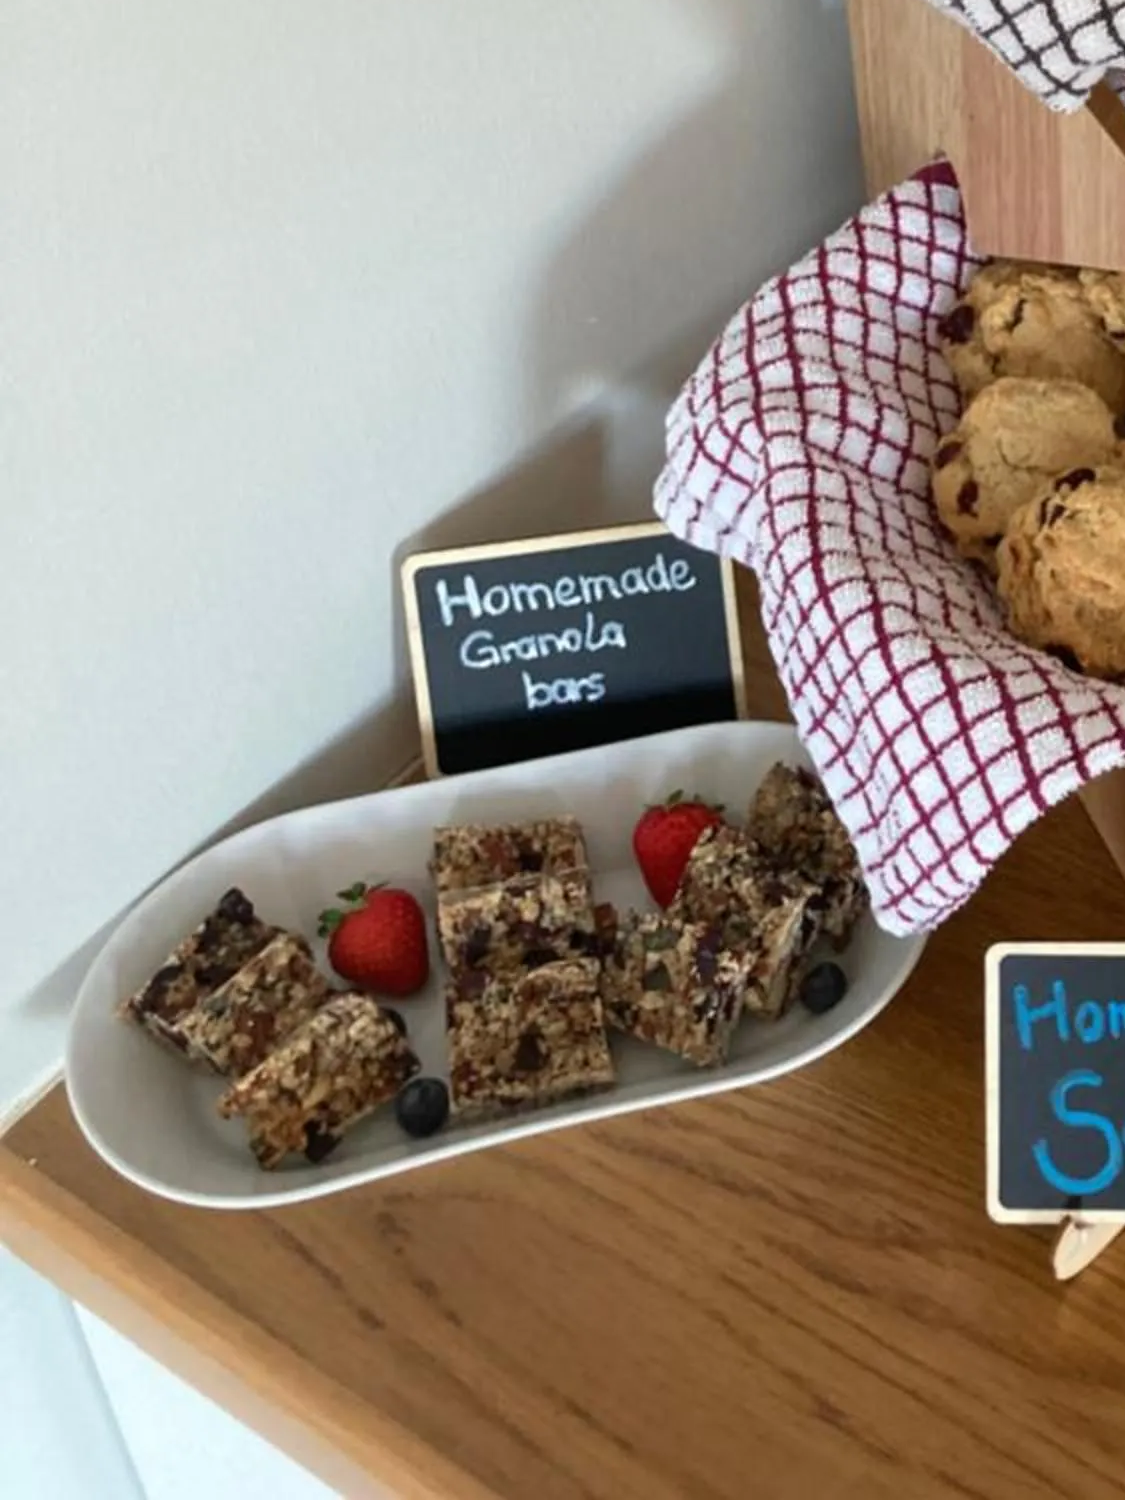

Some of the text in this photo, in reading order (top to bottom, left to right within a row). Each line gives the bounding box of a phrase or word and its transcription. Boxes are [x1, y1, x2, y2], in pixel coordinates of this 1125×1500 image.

[435, 553, 697, 627] Homemade
[460, 612, 627, 669] Granola
[522, 671, 606, 710] bars
